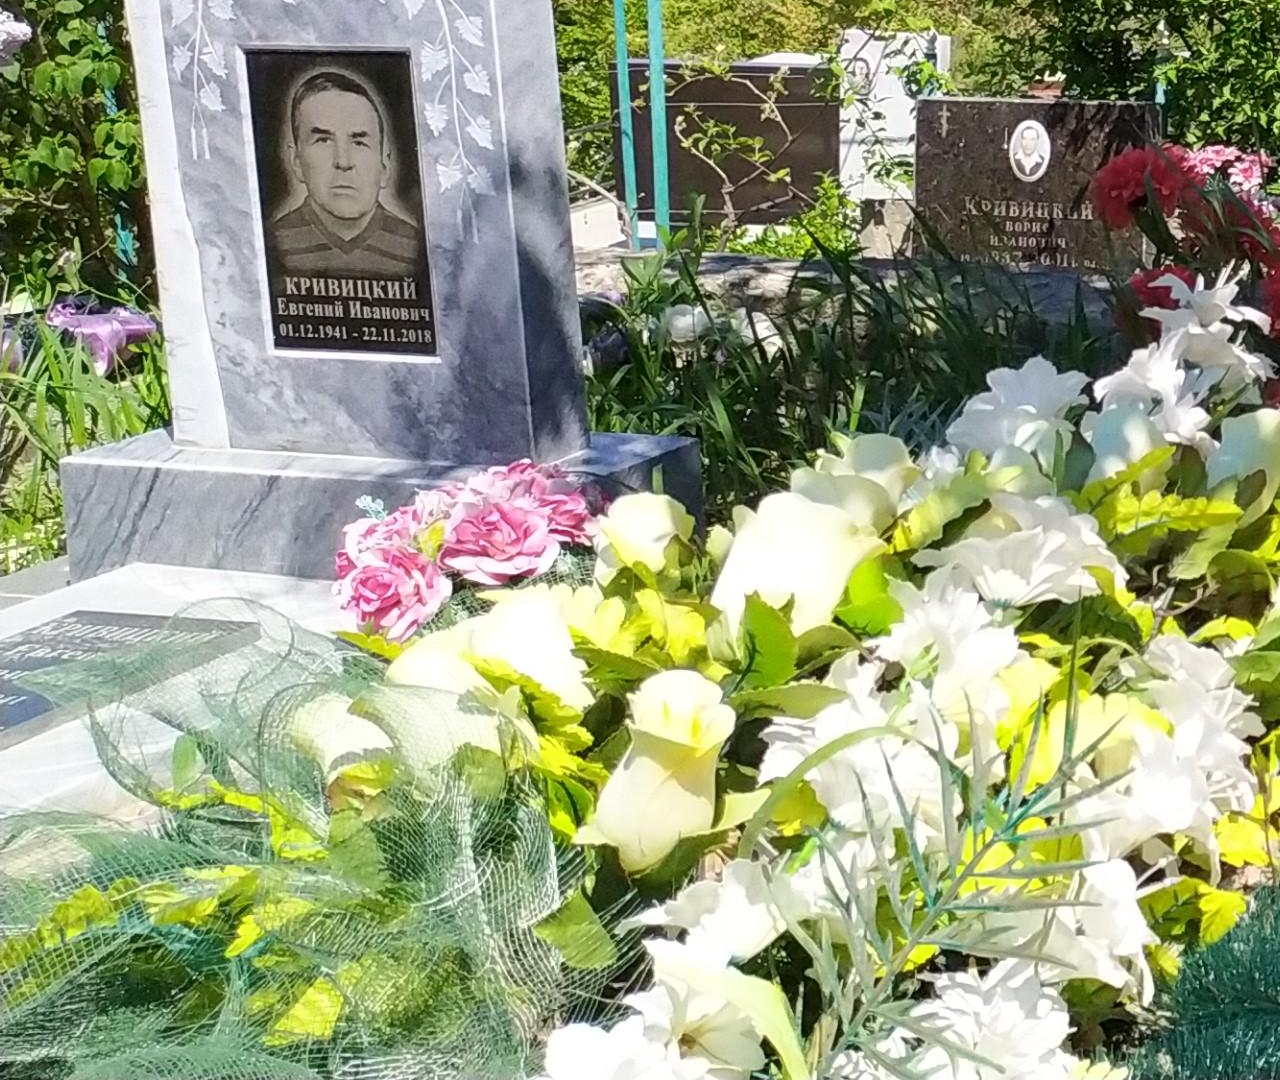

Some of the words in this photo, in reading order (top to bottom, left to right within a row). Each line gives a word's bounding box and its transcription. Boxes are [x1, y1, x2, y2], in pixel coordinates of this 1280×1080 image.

[284, 275, 418, 302] КРИВИЦКИЙ
[276, 297, 345, 318] Евгений
[348, 300, 431, 322] Иванович
[279, 322, 348, 341] 01.12.1941
[361, 325, 433, 344] 22.11.2018
